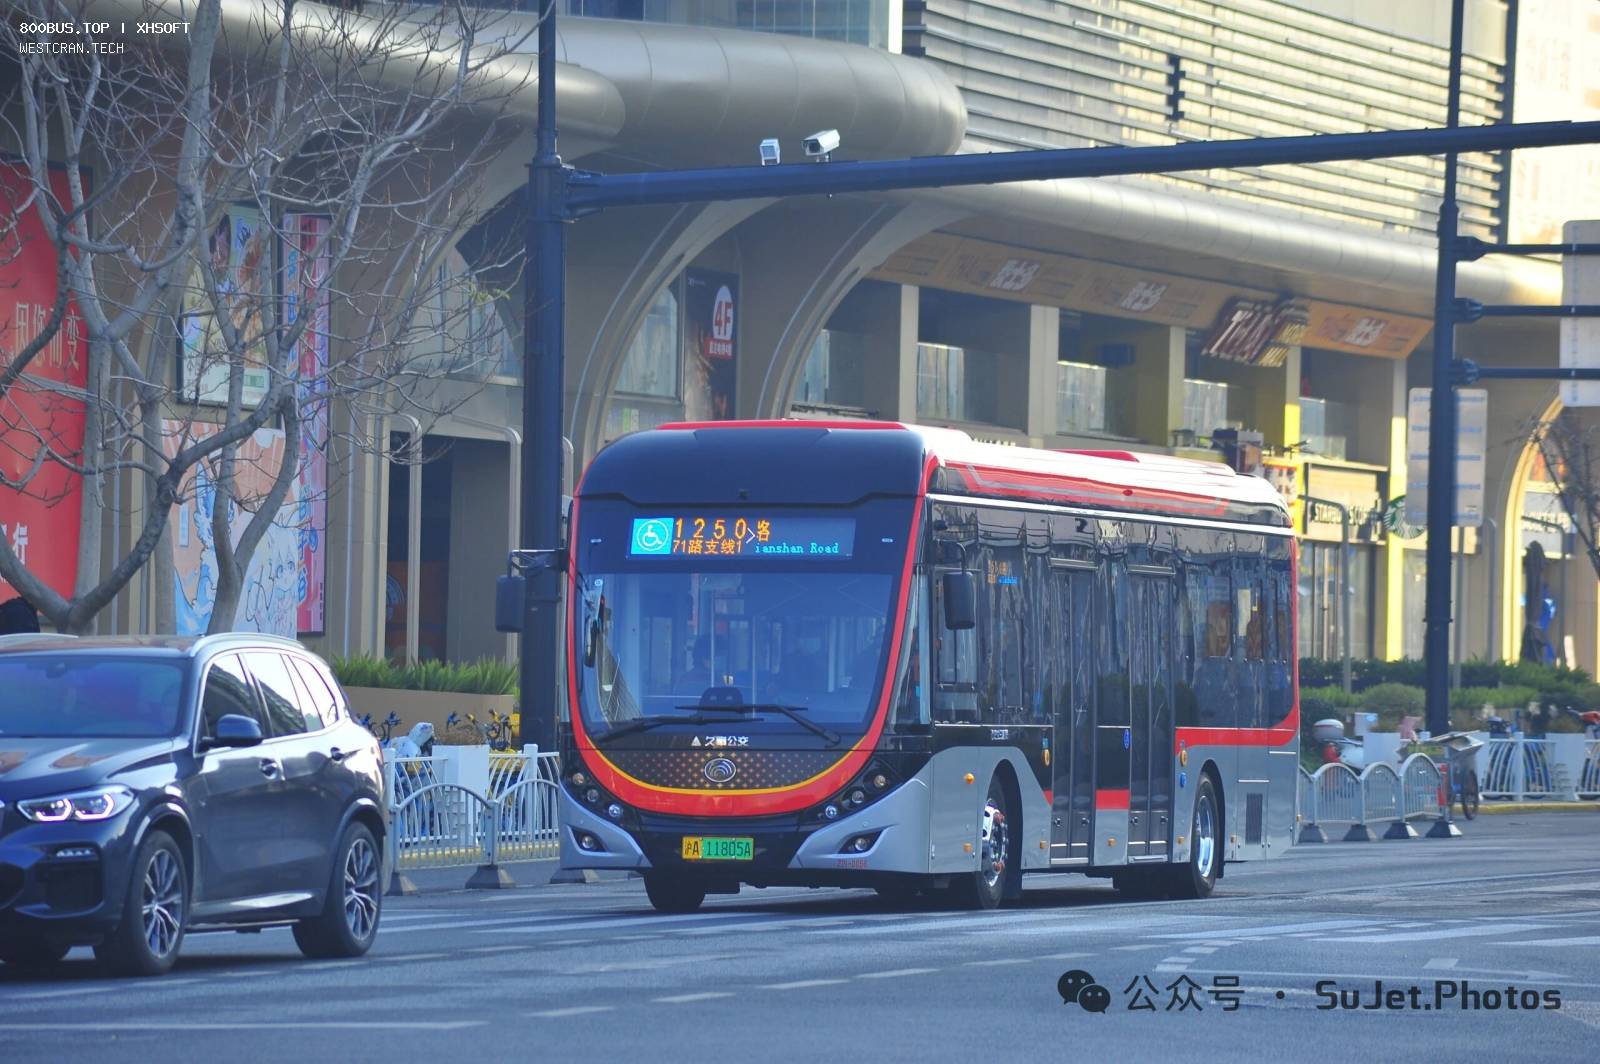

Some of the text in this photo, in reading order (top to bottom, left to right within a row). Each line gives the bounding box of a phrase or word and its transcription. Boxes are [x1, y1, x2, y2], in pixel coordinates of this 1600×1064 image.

[714, 300, 733, 337] 4F
[672, 539, 743, 554] 71路支线1
[755, 542, 840, 553] ianshan Road
[706, 841, 752, 857] 11805A
